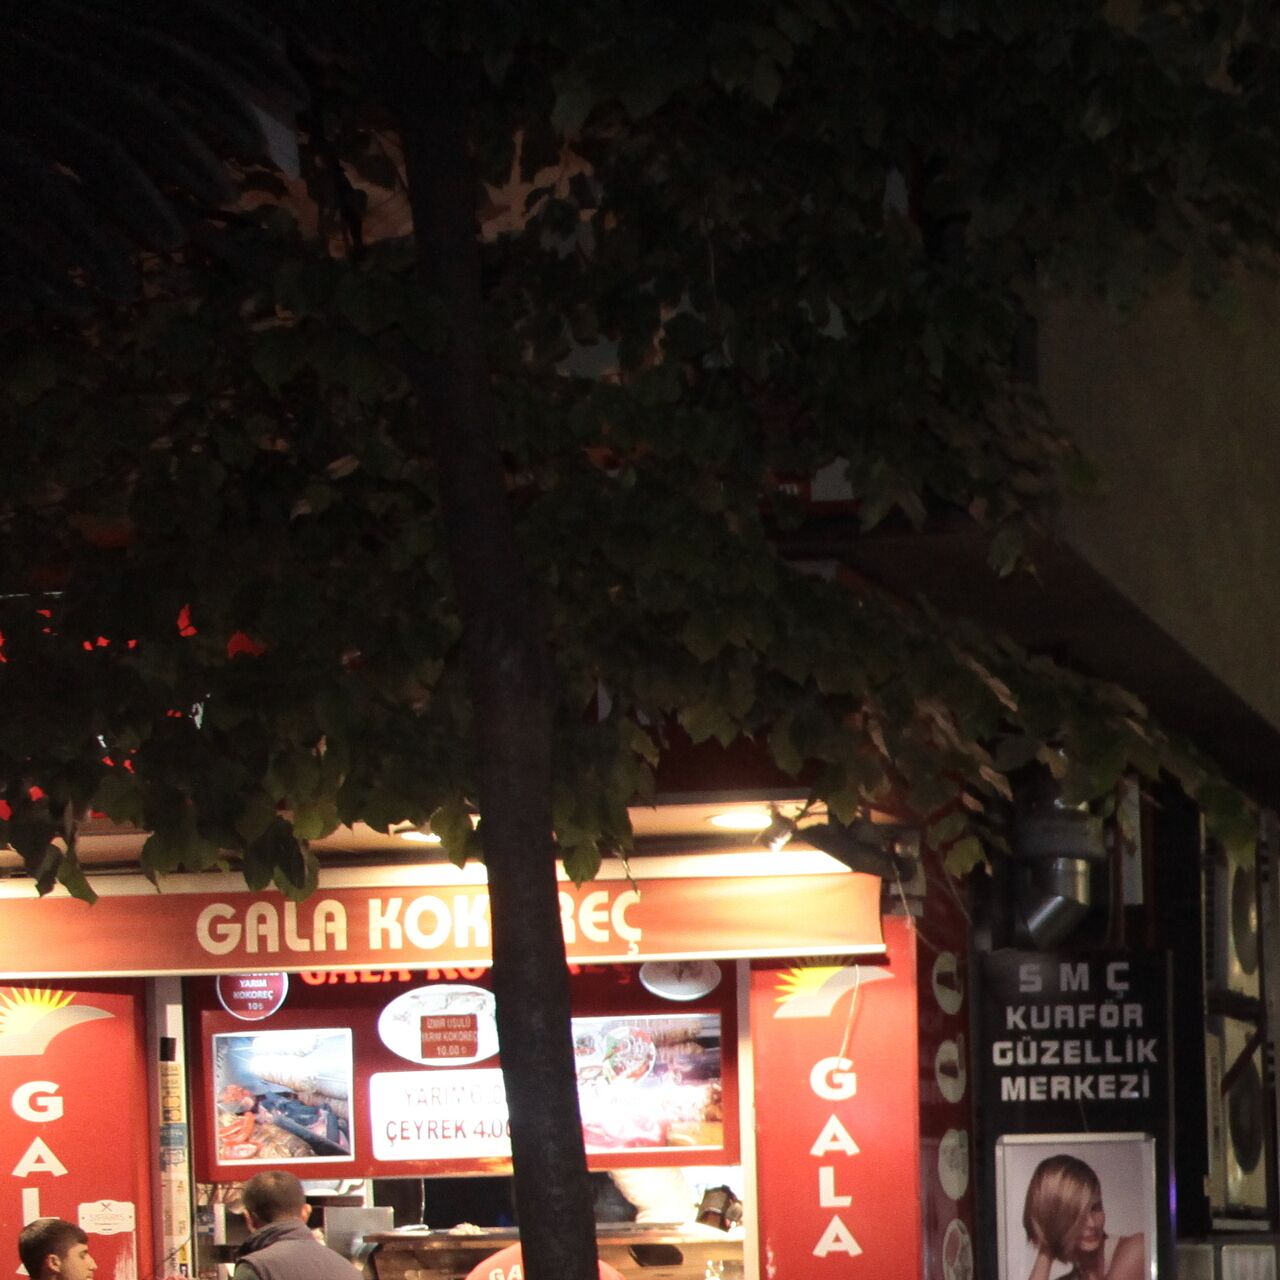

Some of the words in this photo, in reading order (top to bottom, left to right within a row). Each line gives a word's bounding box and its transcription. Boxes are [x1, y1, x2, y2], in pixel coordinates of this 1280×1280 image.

[196, 898, 348, 956] GALA
[368, 889, 642, 957] KOKEÇ
[1006, 1000, 1144, 1031] KUAFÖR
[992, 1035, 1158, 1067] GÜZELLİK
[1001, 1069, 1150, 1101] MERKEZİ
[386, 1121, 467, 1147] ÇEYREK
[809, 1056, 864, 1258] GALA
[11, 1080, 69, 1276] GAL
